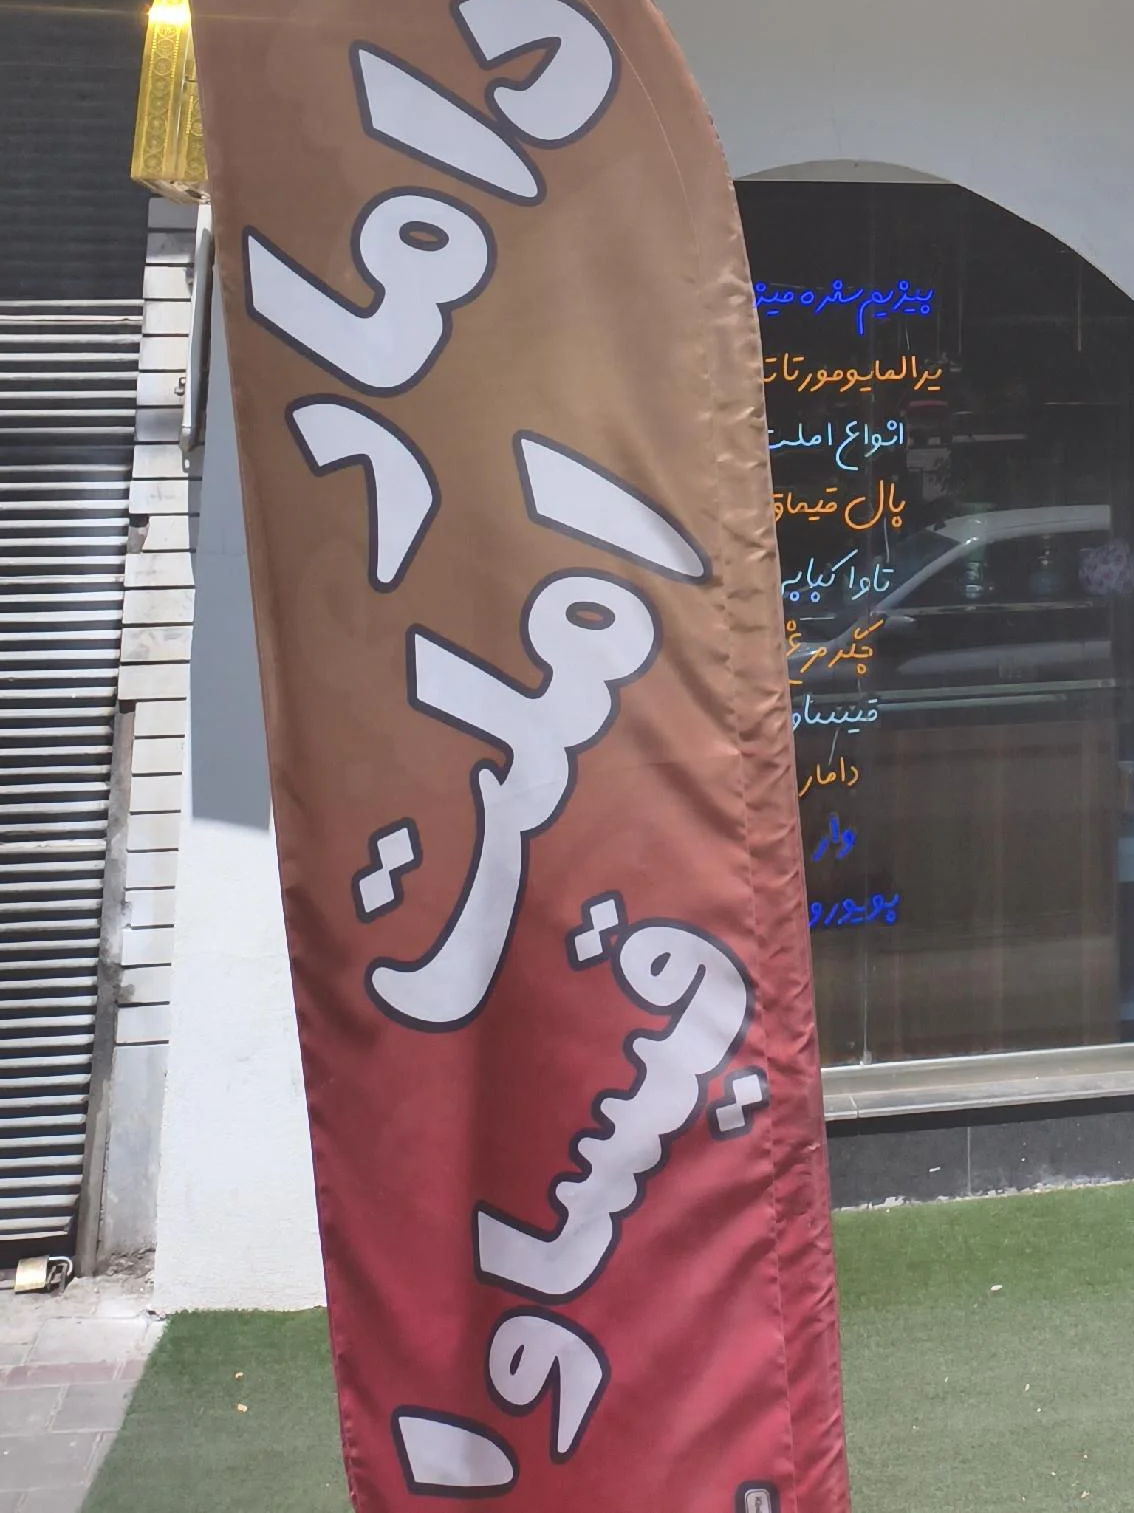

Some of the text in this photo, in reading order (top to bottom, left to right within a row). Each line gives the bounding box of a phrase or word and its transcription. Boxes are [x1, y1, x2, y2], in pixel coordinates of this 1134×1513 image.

[835, 419, 905, 472] انواع
[844, 479, 907, 530] بال
[848, 562, 895, 601] تاوا
[352, 429, 714, 1034] املت
[790, 693, 879, 734] قیساو
[808, 892, 901, 929] بویورو
